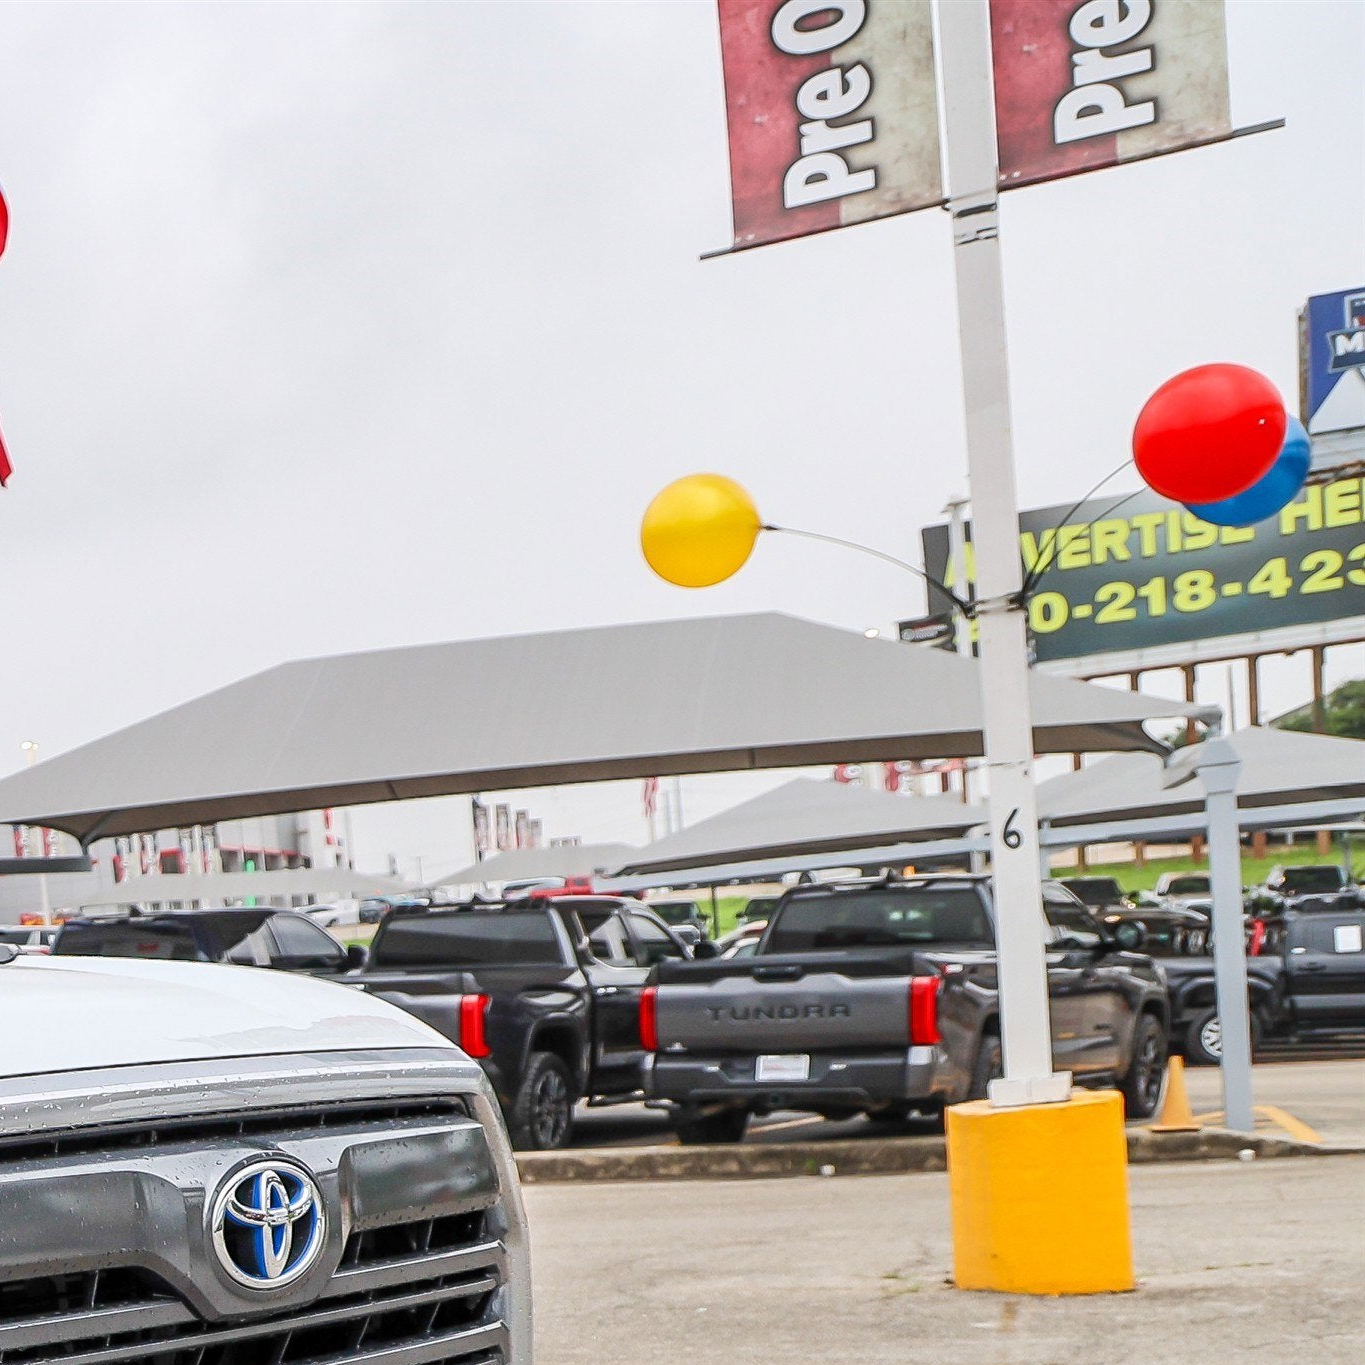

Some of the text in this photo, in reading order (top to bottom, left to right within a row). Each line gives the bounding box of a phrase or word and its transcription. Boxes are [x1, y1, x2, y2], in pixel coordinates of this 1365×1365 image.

[1054, 0, 1155, 144] Pre
[783, 64, 876, 209] Pre
[944, 477, 1365, 588] VERTIS HE
[1003, 807, 1022, 849] 6
[707, 1003, 851, 1021] TUNDRA
